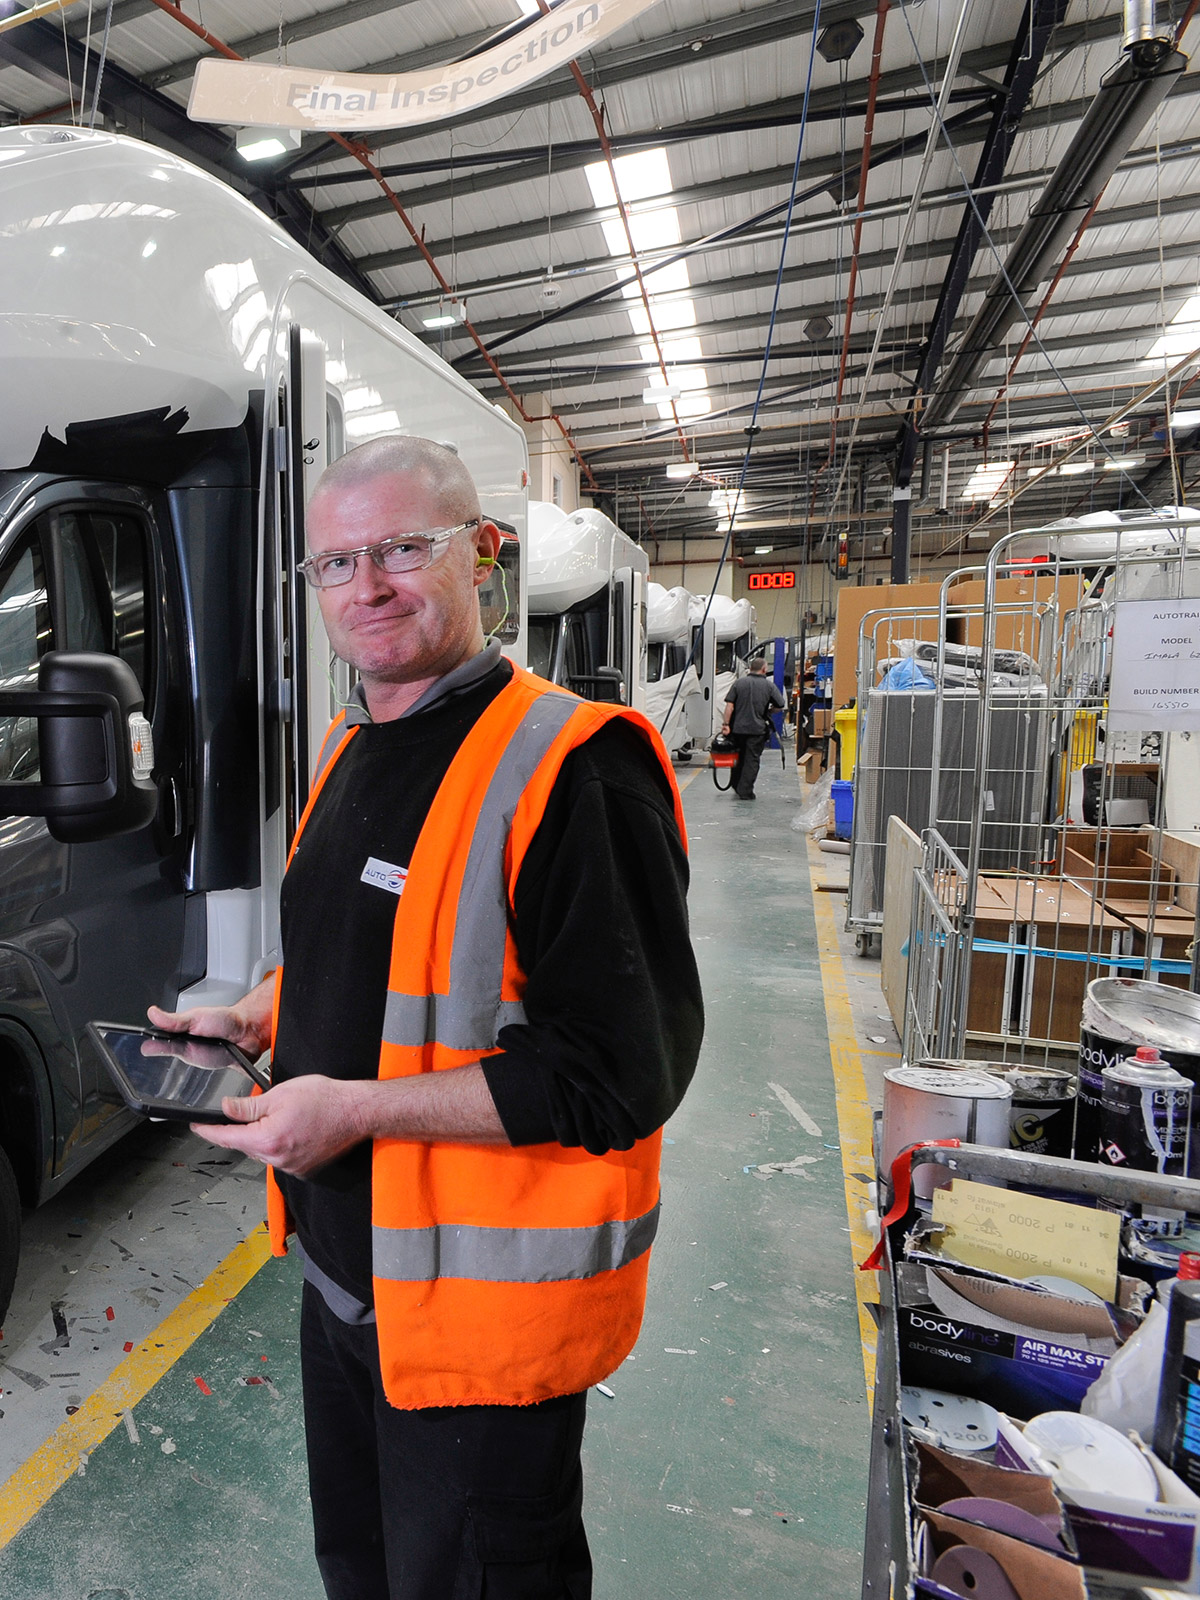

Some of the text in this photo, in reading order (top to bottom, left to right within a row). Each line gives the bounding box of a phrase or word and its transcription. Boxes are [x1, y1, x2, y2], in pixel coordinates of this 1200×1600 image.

[286, 2, 601, 112] Final Inspection
[749, 571, 796, 590] 00:08
[1152, 611, 1200, 620] AUTOTRAI
[1160, 687, 1200, 695] NUMBER
[365, 869, 387, 881] AUTO
[974, 1203, 996, 1214] 1913
[1008, 1213, 1041, 1229] 2000
[1045, 1223, 1056, 1233] P
[1006, 1247, 1039, 1263] 2000
[1042, 1258, 1053, 1268] P
[909, 1312, 1000, 1347] bodyline
[908, 1340, 973, 1365] abrasives
[1022, 1340, 1110, 1368] AIR MAX ST
[1037, 1352, 1067, 1364] abrasive
[1145, 1508, 1197, 1519] BODYLINE
